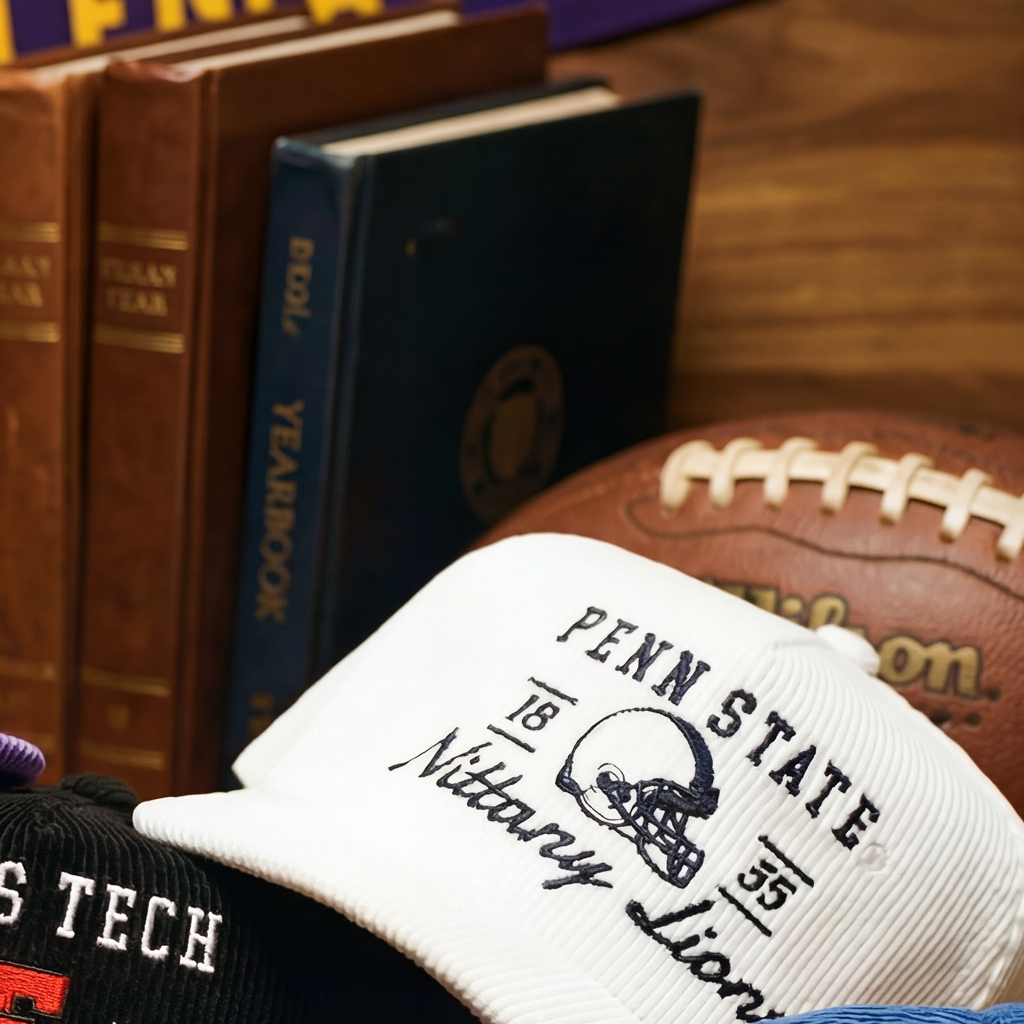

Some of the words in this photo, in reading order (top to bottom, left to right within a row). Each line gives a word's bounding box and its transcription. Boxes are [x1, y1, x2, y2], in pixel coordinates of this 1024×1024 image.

[254, 399, 305, 624] YEARBOOK
[505, 694, 561, 732] 18
[555, 605, 711, 706] PENN
[706, 688, 882, 851] STATE
[56, 871, 223, 973] TECH
[388, 727, 614, 890] Nittany
[626, 899, 785, 1023] Lion
[738, 859, 797, 910] 55
